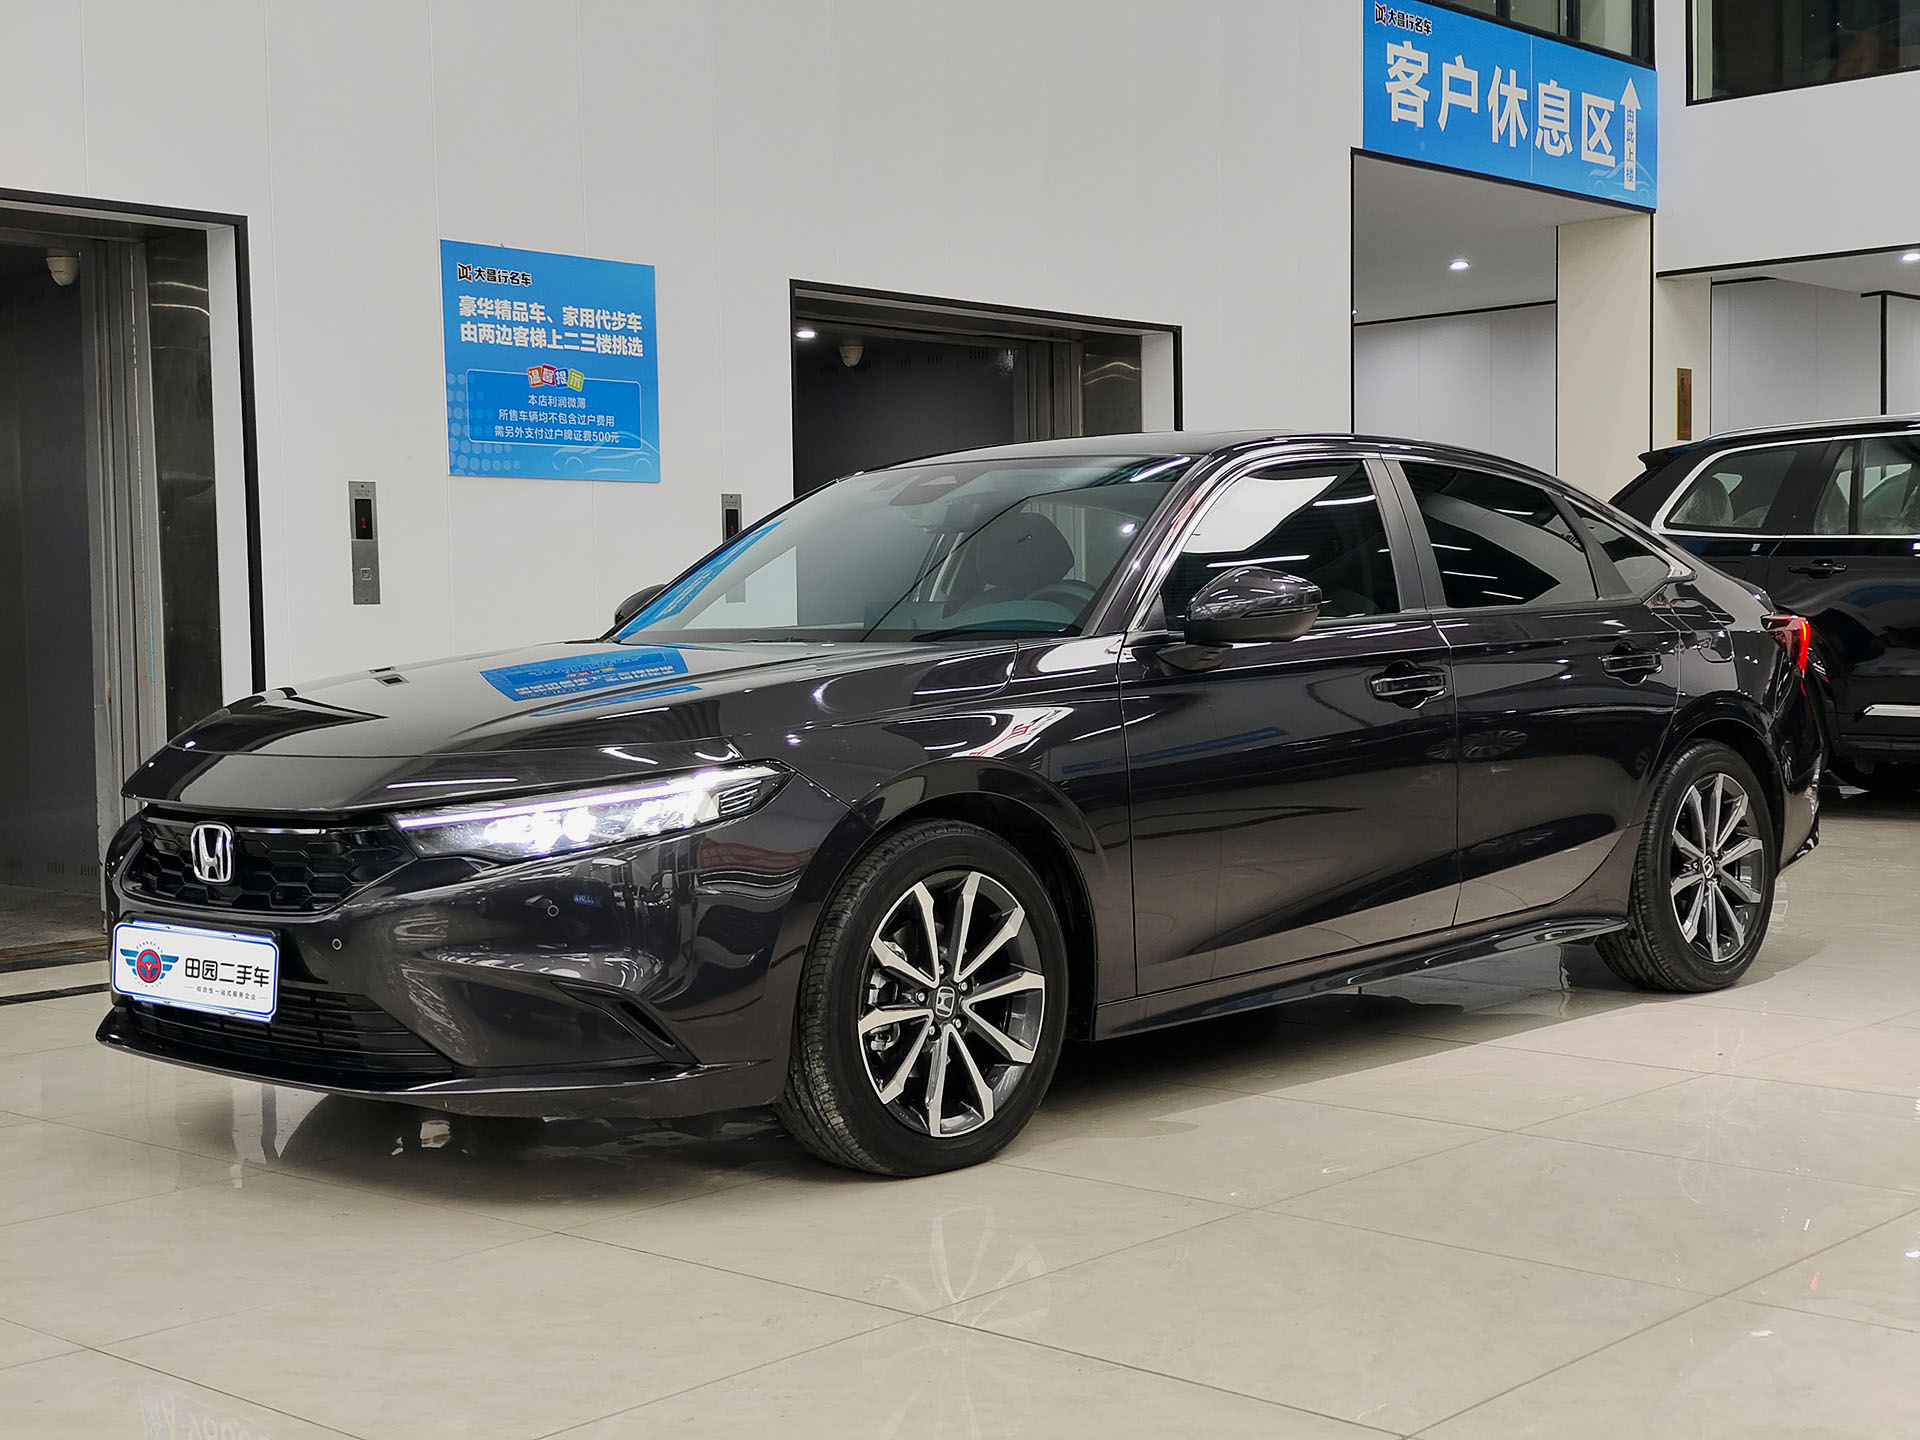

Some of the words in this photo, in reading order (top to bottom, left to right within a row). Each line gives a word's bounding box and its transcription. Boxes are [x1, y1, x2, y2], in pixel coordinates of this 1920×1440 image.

[1388, 9, 1433, 35] 大昌行名车
[1385, 40, 1617, 168] 客户休息区
[474, 267, 532, 286] 大昌行名车
[460, 321, 644, 357] 由两边客梯上二三楼挑选
[528, 366, 582, 390] 温馨提示
[528, 394, 586, 409] 本店利润微薄
[498, 408, 615, 428] 所售车辆均不包含过户费用
[494, 425, 620, 443] 需另外支付过户牌证费500元
[185, 957, 270, 987] 田园二手车
